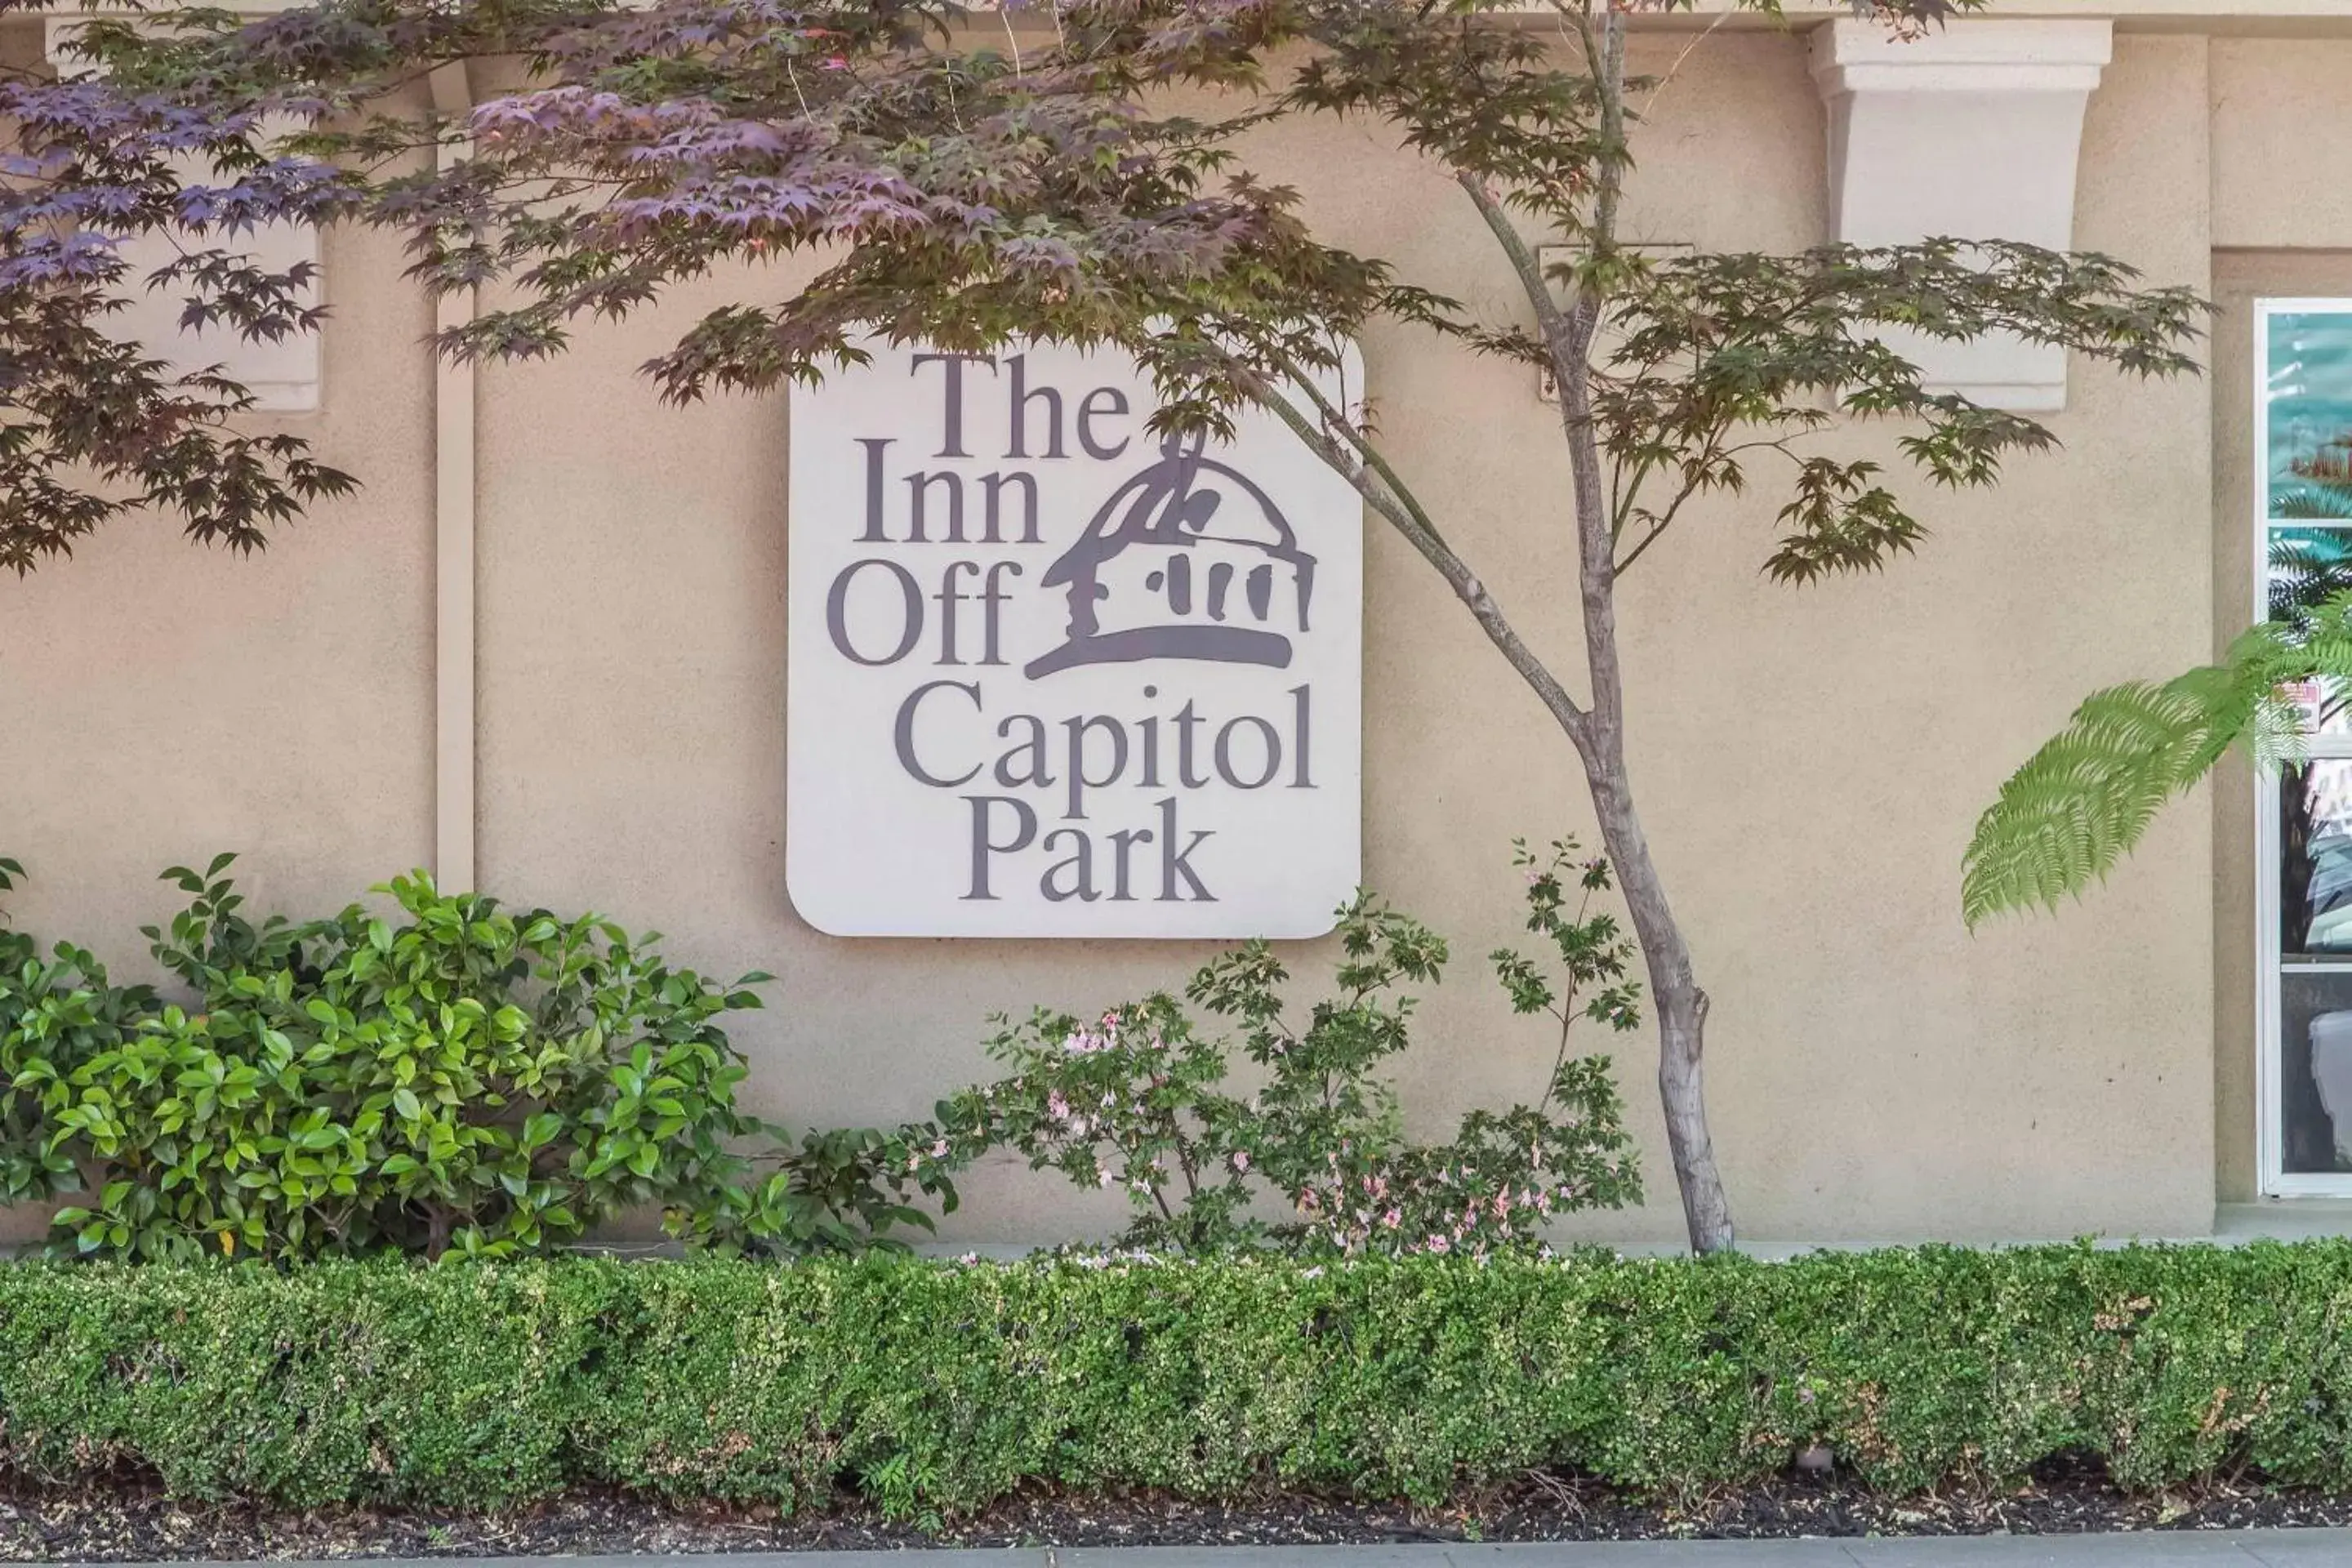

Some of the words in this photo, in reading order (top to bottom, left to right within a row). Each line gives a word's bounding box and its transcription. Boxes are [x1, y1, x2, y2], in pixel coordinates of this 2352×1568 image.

[910, 353, 1130, 461] The
[852, 438, 1046, 543] Inn
[826, 559, 1023, 666] Off
[894, 679, 1318, 820] Capitol
[958, 795, 1219, 902] Park
